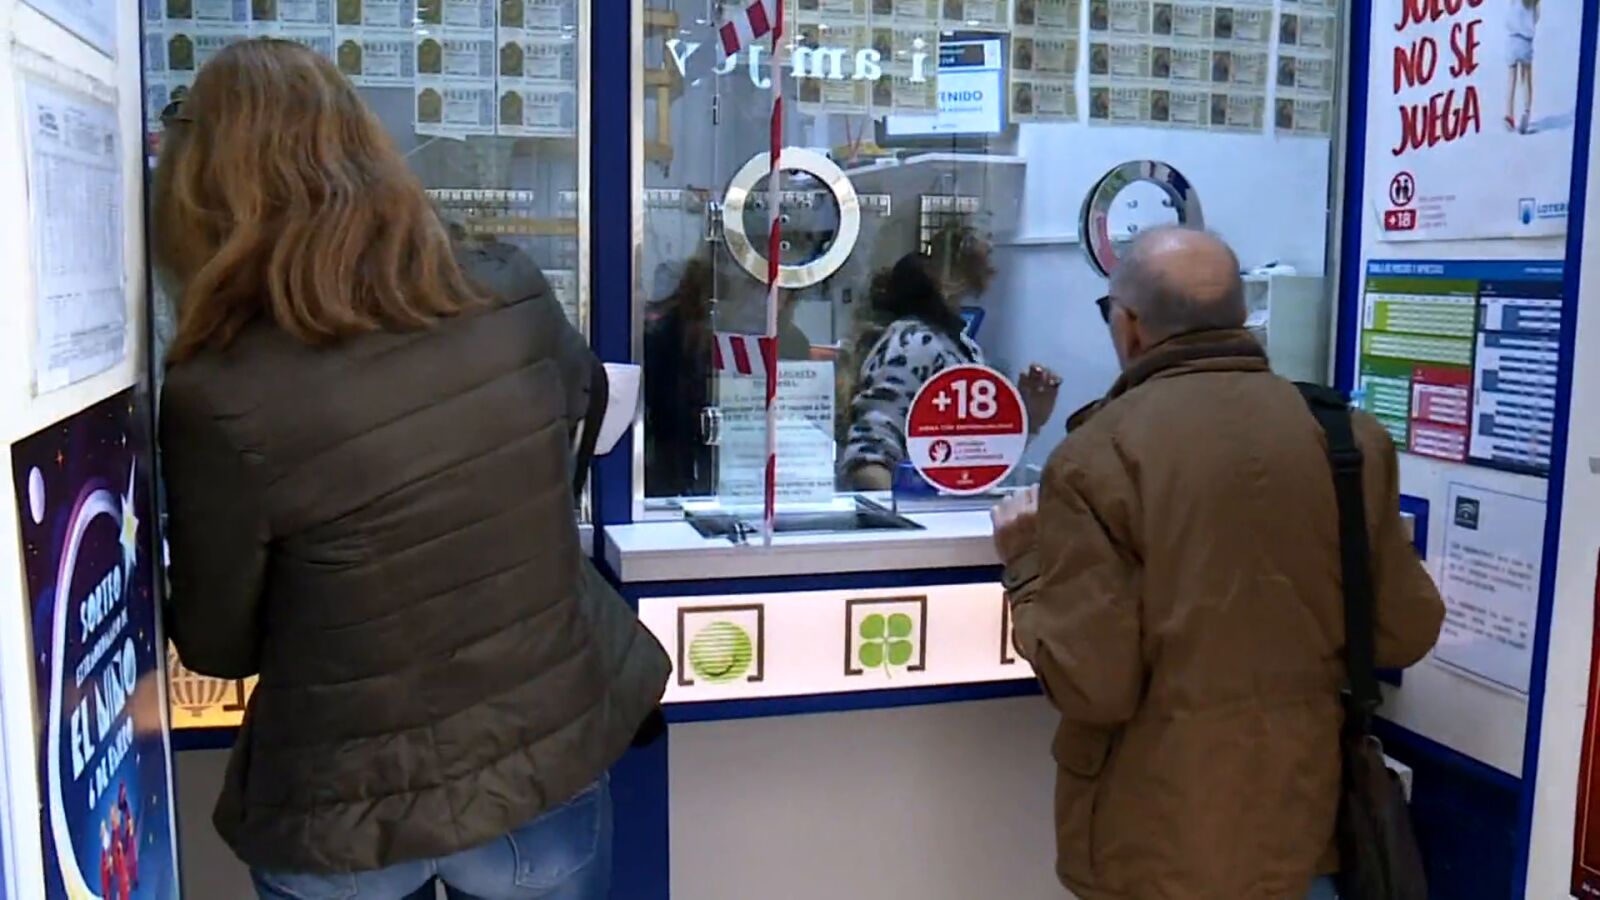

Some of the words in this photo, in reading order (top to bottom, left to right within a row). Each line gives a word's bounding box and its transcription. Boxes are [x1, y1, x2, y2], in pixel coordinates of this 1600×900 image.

[1393, 36, 1437, 95] NO
[1449, 19, 1482, 78] SE
[1392, 85, 1481, 156] JUEGA
[931, 379, 998, 419] +18
[71, 694, 96, 781] EL
